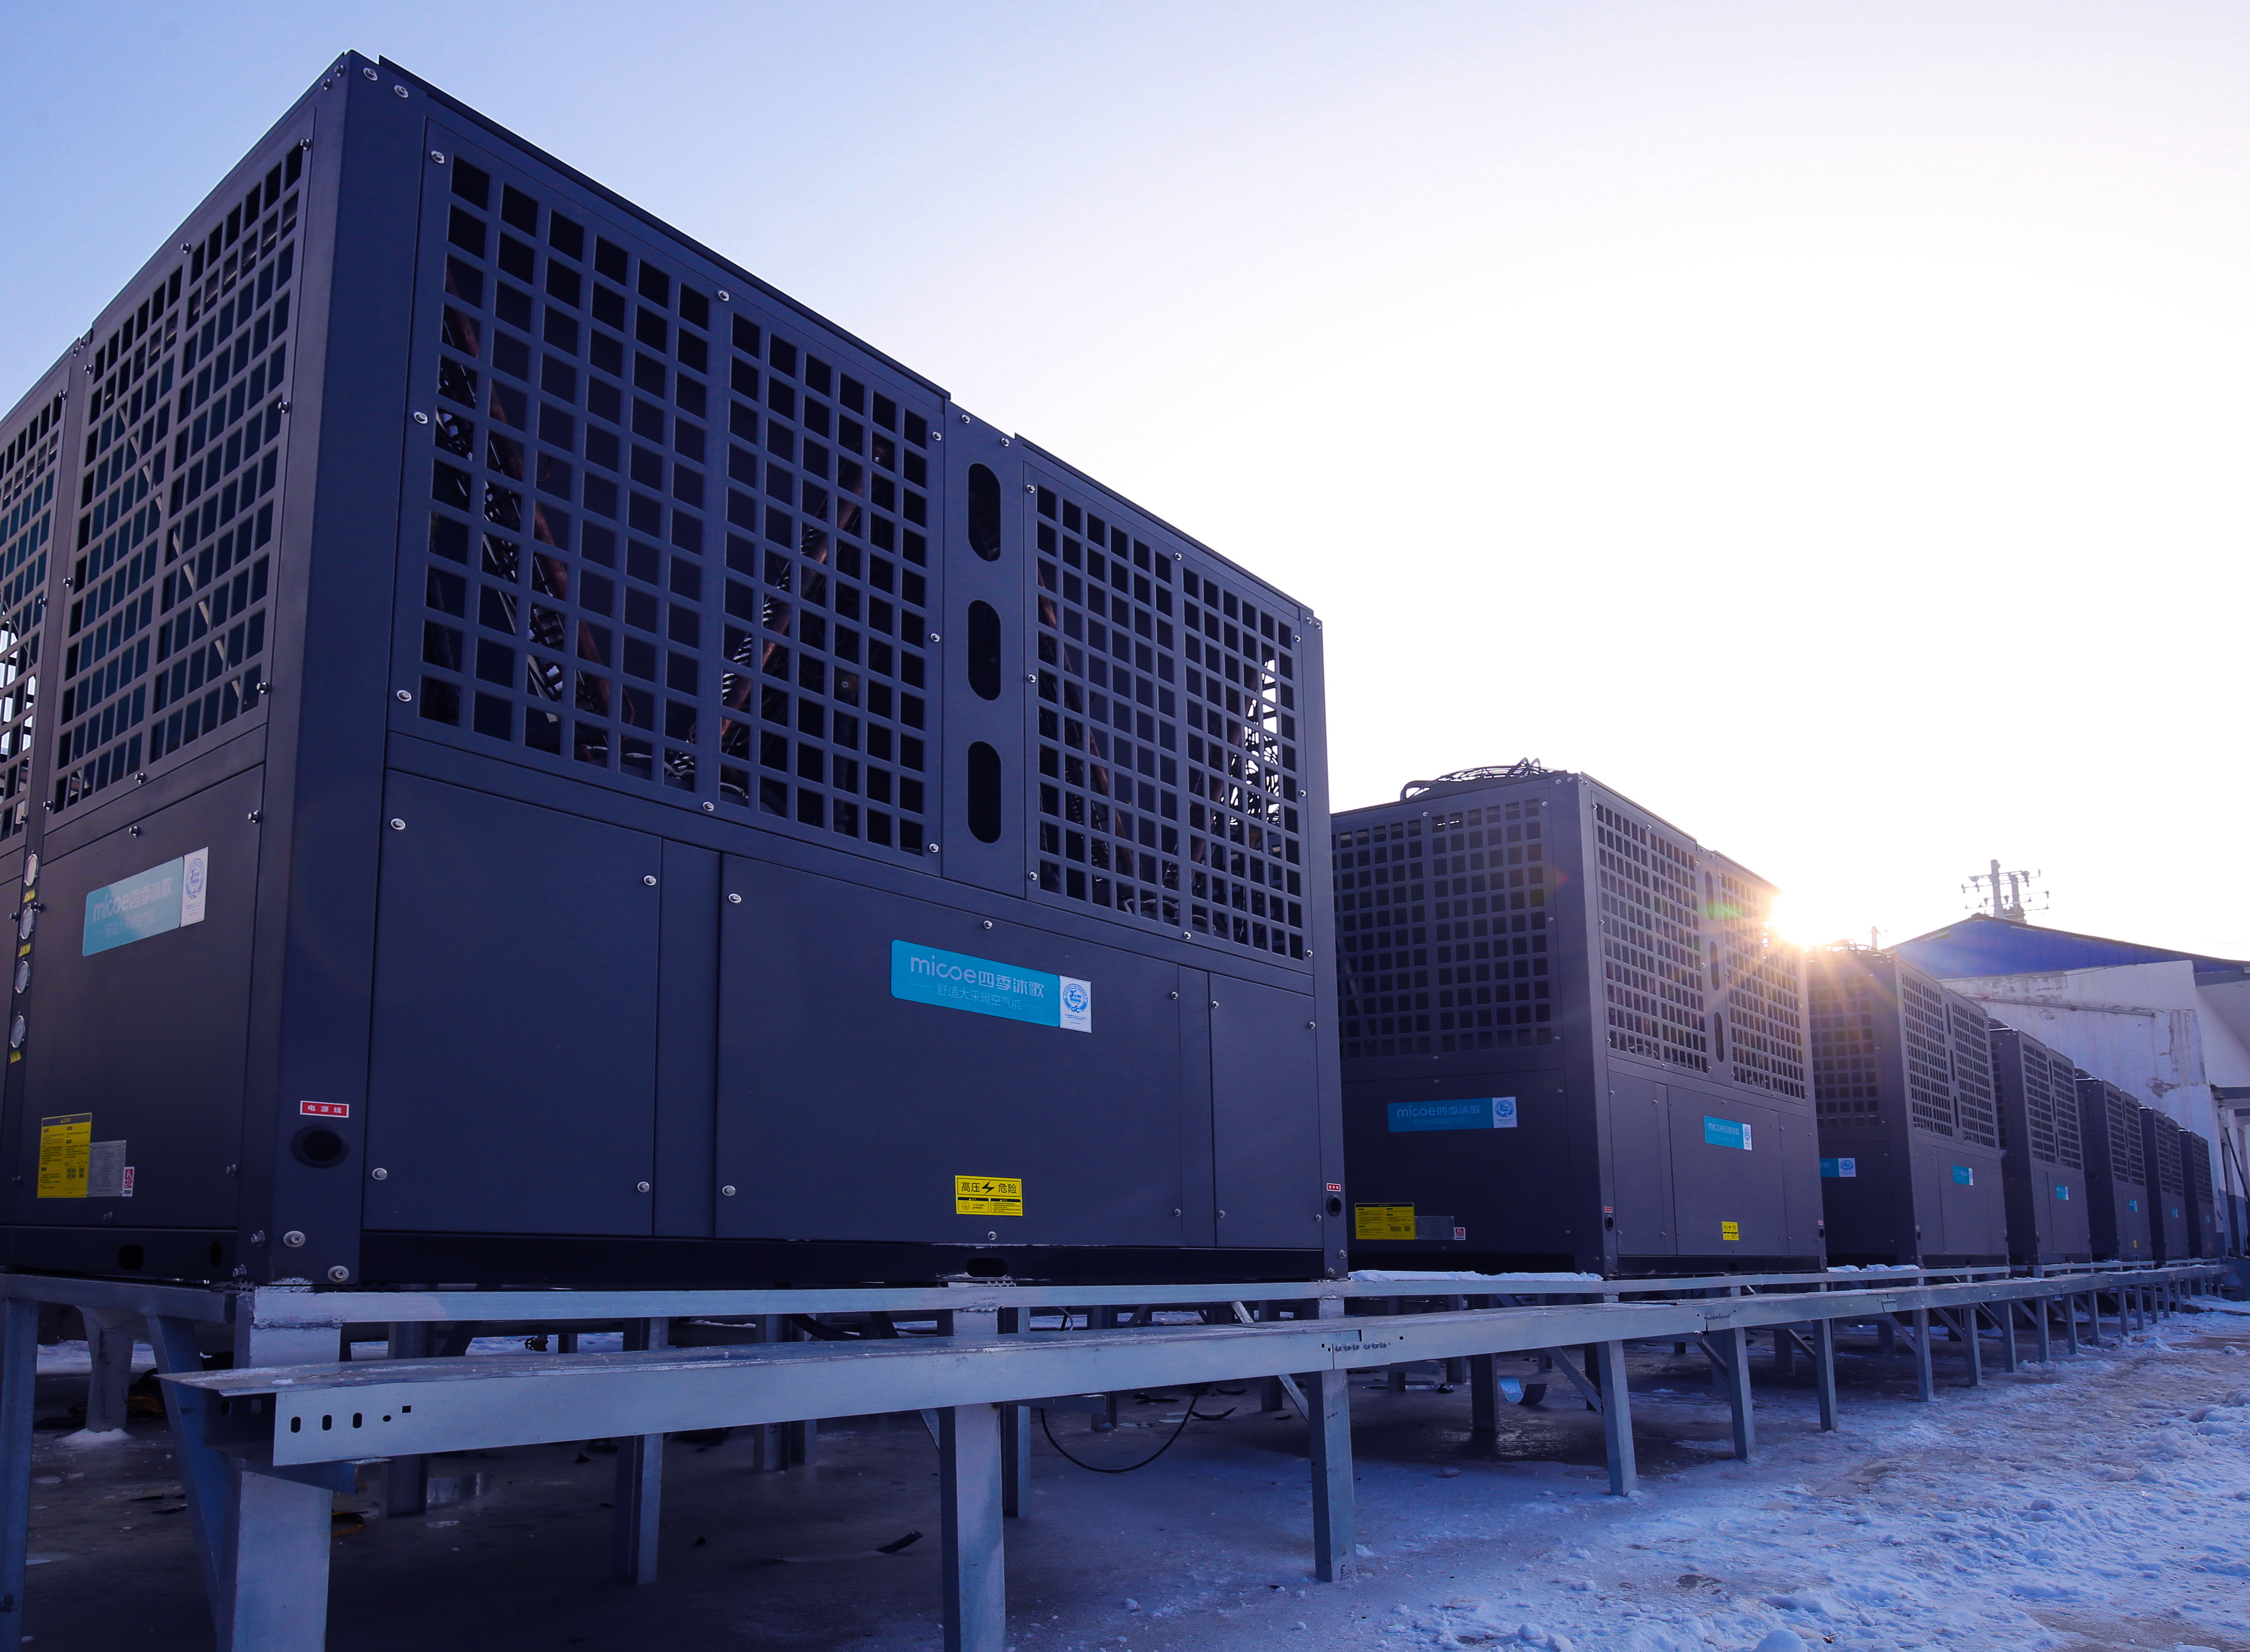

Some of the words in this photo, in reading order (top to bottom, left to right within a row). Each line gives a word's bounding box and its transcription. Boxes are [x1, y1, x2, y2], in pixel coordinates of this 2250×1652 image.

[93, 893, 130, 922] micoe
[910, 955, 977, 984] micoe
[978, 971, 1044, 998] 四季沐歌
[937, 983, 1022, 1010] 舒适大采暖空气能
[1397, 1105, 1436, 1118] micoe
[961, 1182, 981, 1192] 高压
[998, 1183, 1017, 1194] 危险
